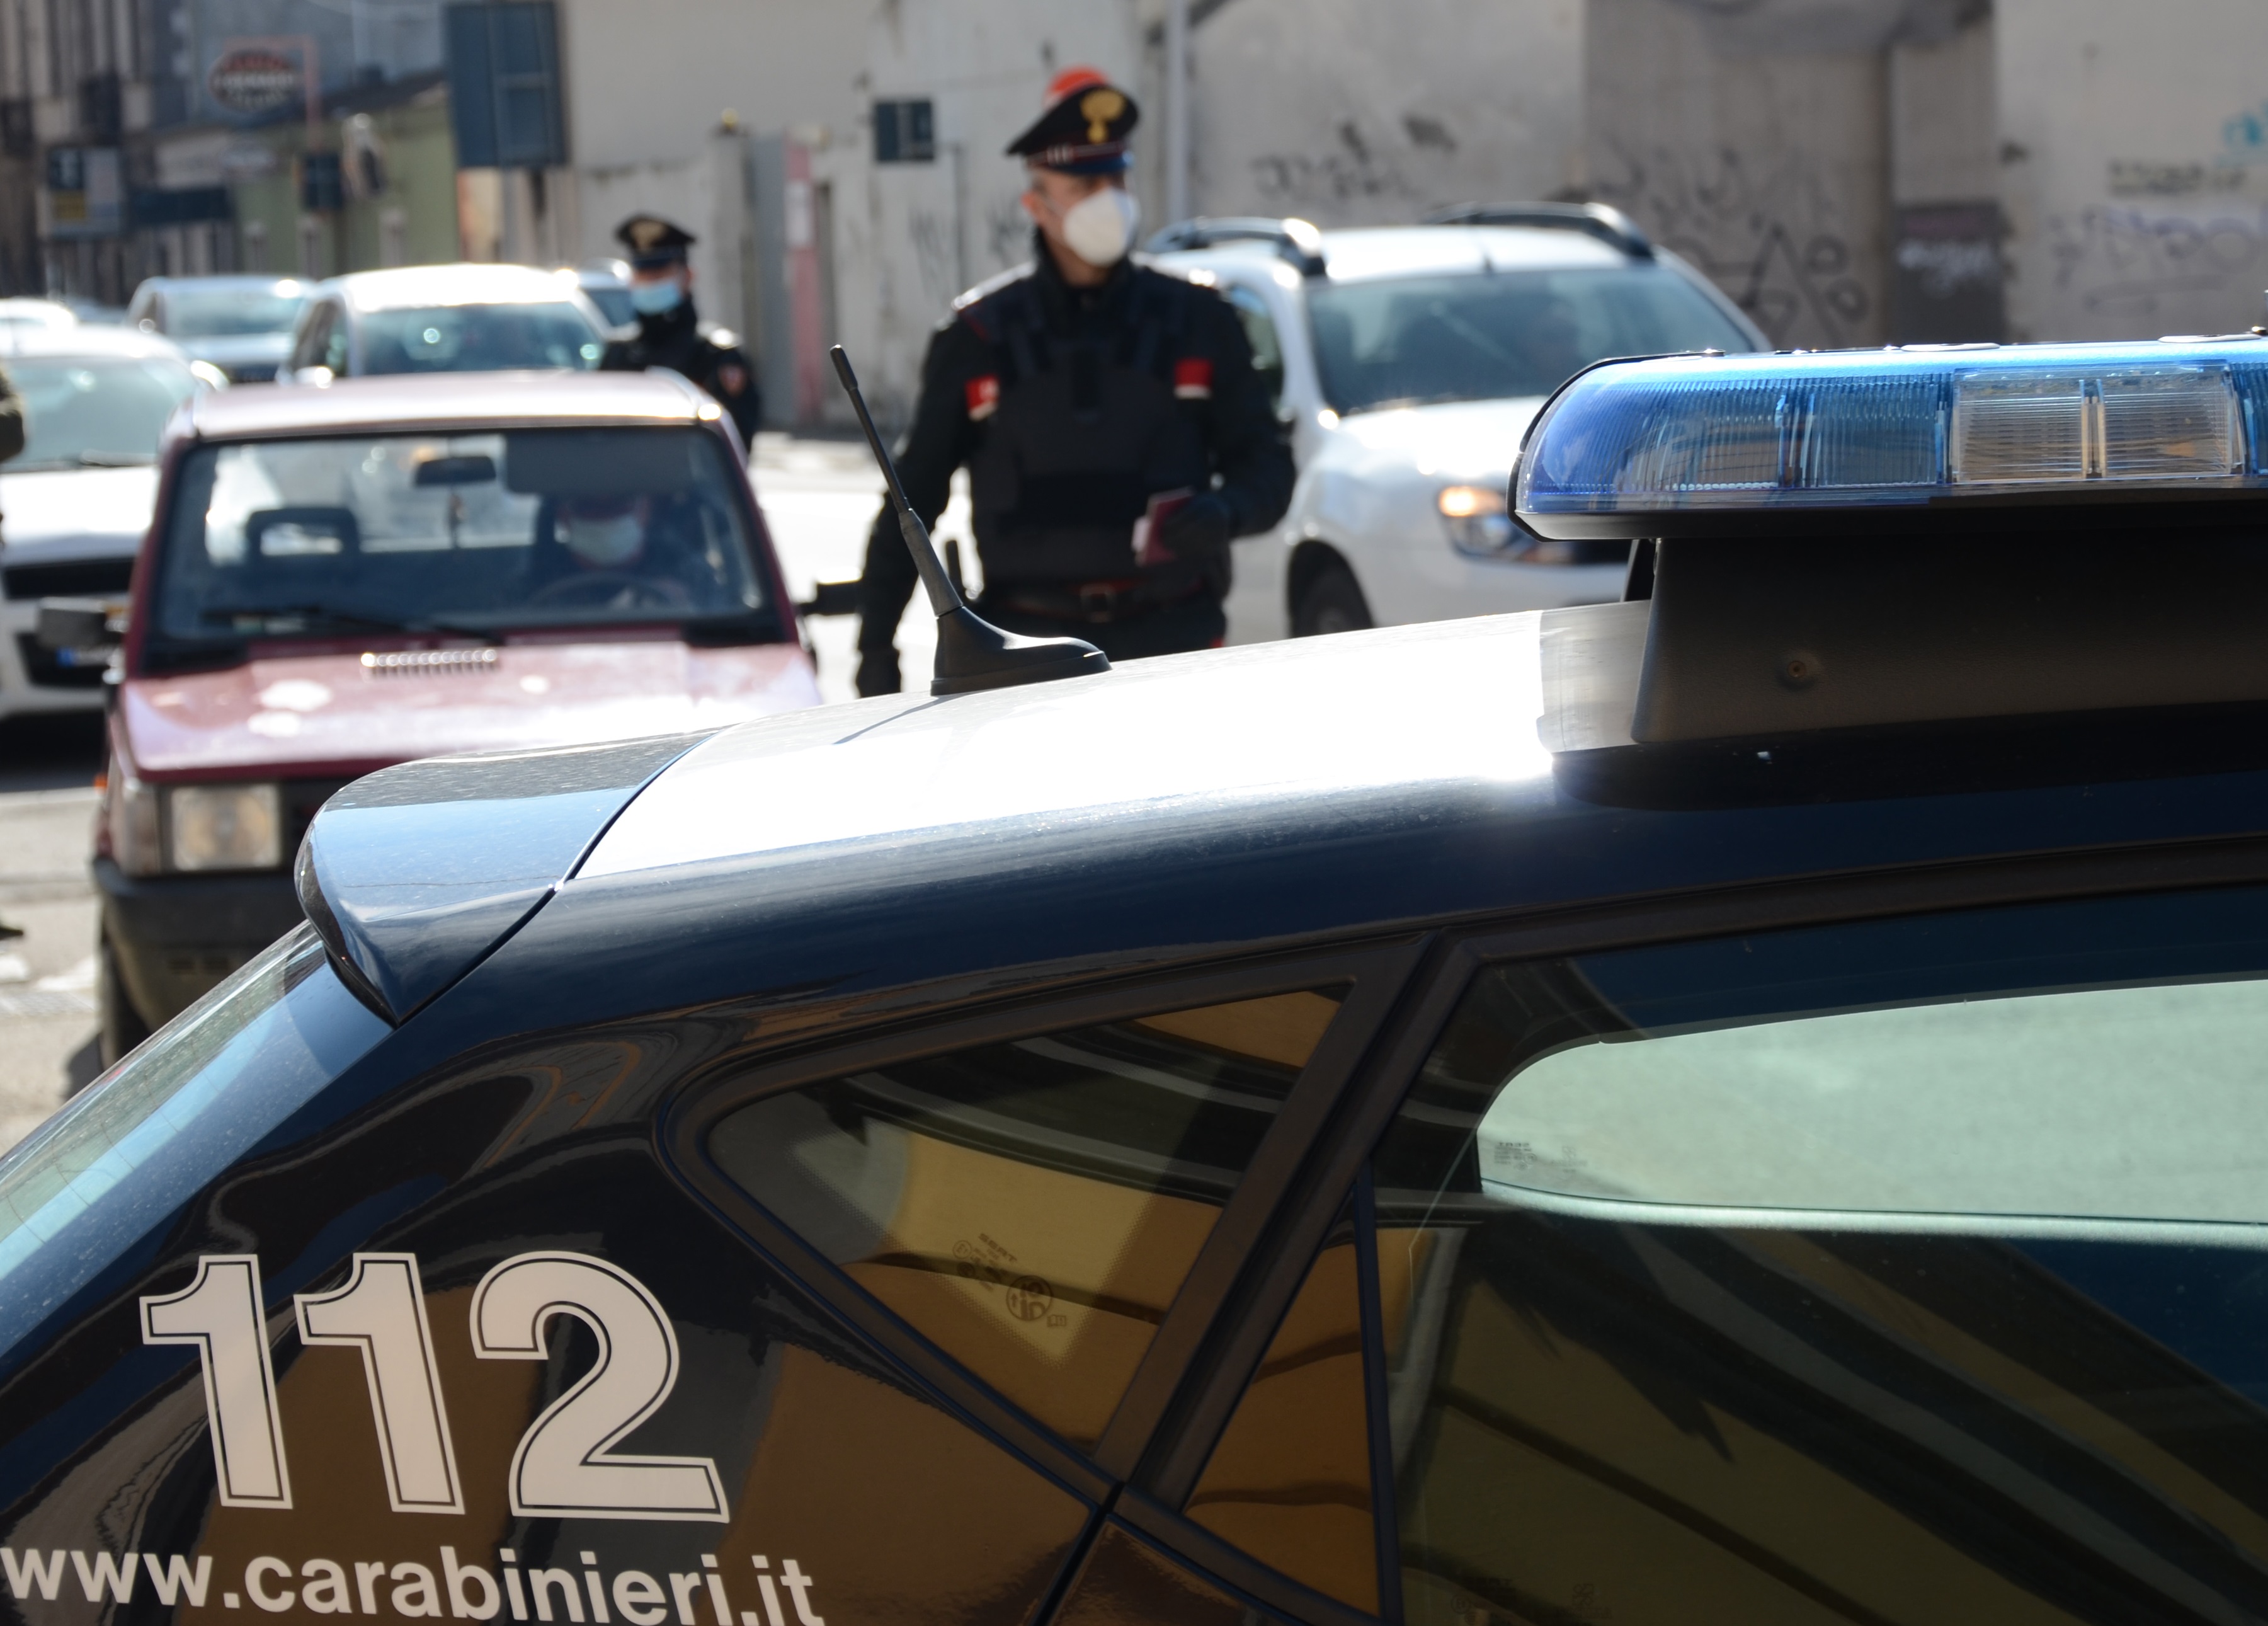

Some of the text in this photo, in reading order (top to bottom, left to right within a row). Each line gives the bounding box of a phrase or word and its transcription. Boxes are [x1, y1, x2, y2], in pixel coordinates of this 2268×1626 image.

[977, 1232, 1018, 1262] SEAT
[139, 1250, 730, 1523] 112
[0, 1545, 826, 1626] www.carabinieri.it
